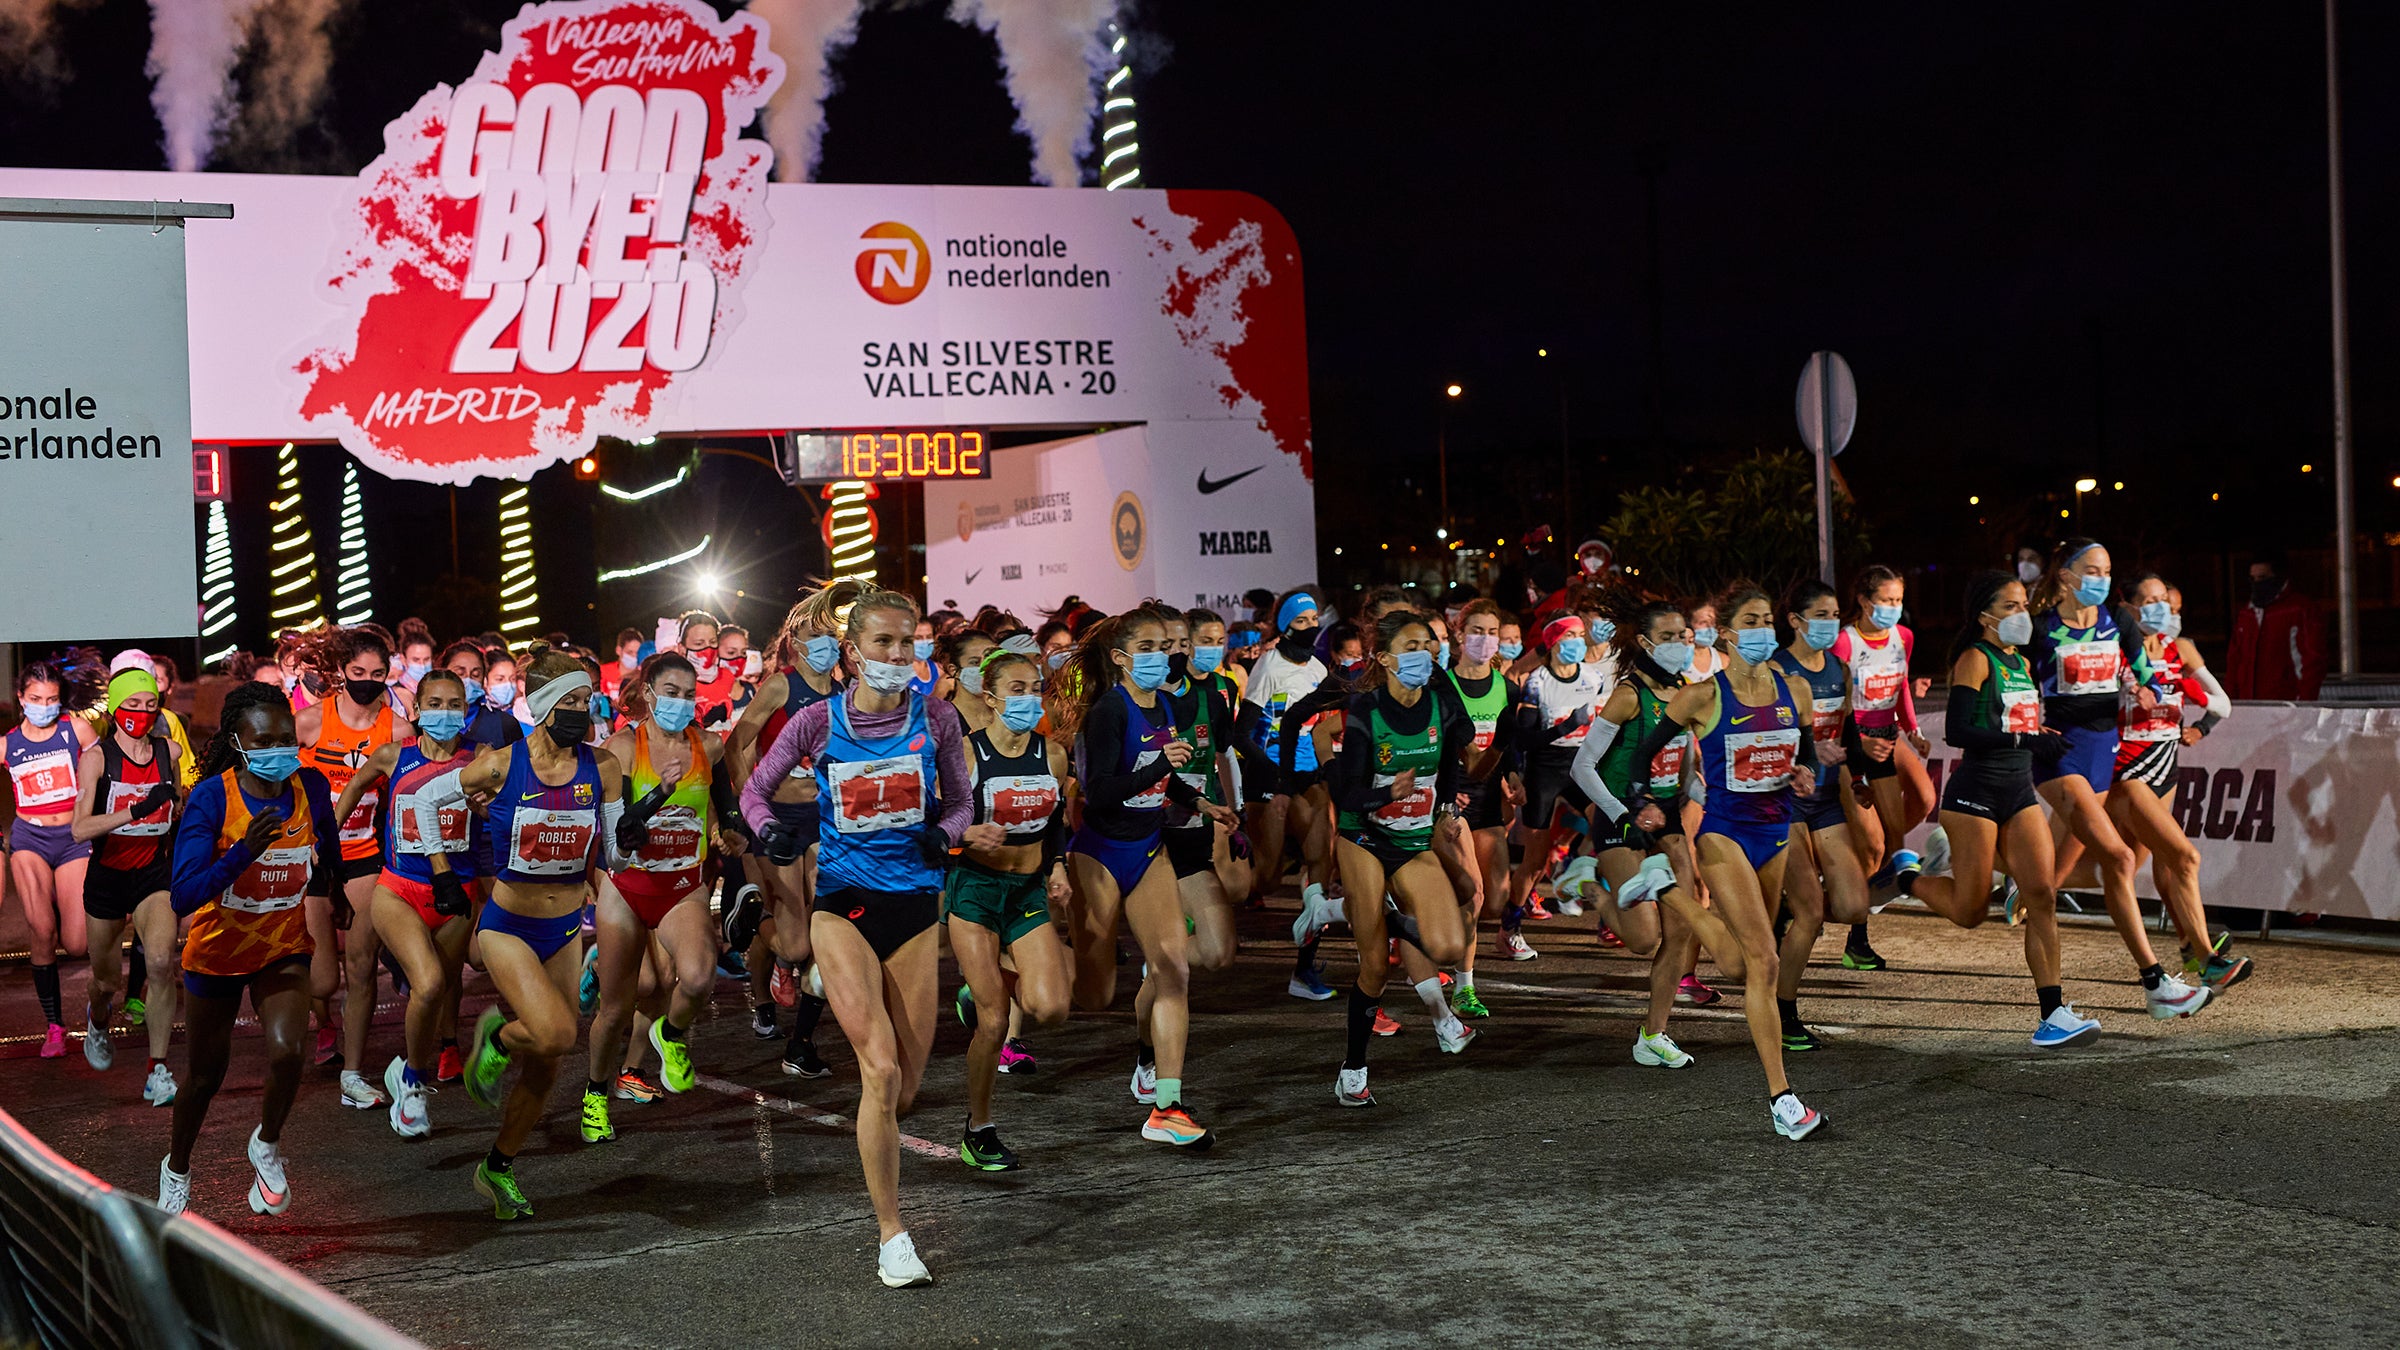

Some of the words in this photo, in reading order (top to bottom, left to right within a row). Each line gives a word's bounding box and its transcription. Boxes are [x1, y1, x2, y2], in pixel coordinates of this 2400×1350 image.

[440, 82, 710, 200] GOOD
[469, 170, 697, 285] BYE!
[946, 233, 1068, 258] nationale
[947, 263, 1111, 288] nederlanden
[450, 258, 718, 375] 2020
[863, 341, 929, 368] SAN
[942, 340, 1115, 367] SILVESTRE
[864, 370, 1055, 398] VALLECANA
[1080, 370, 1116, 396] 20
[362, 384, 542, 430] MADRID
[842, 432, 983, 478] 18:30:02
[1199, 530, 1273, 556] MARCA
[36, 771, 54, 787] 85
[874, 780, 885, 802] 7
[1012, 795, 1043, 808] ZARBO
[1022, 809, 1032, 819] 17
[2171, 766, 2277, 843] RCA
[438, 815, 454, 825] GO
[538, 831, 577, 844] ROBLES
[551, 846, 560, 856] 11
[260, 870, 289, 883] RUTH
[270, 884, 275, 895] 1
